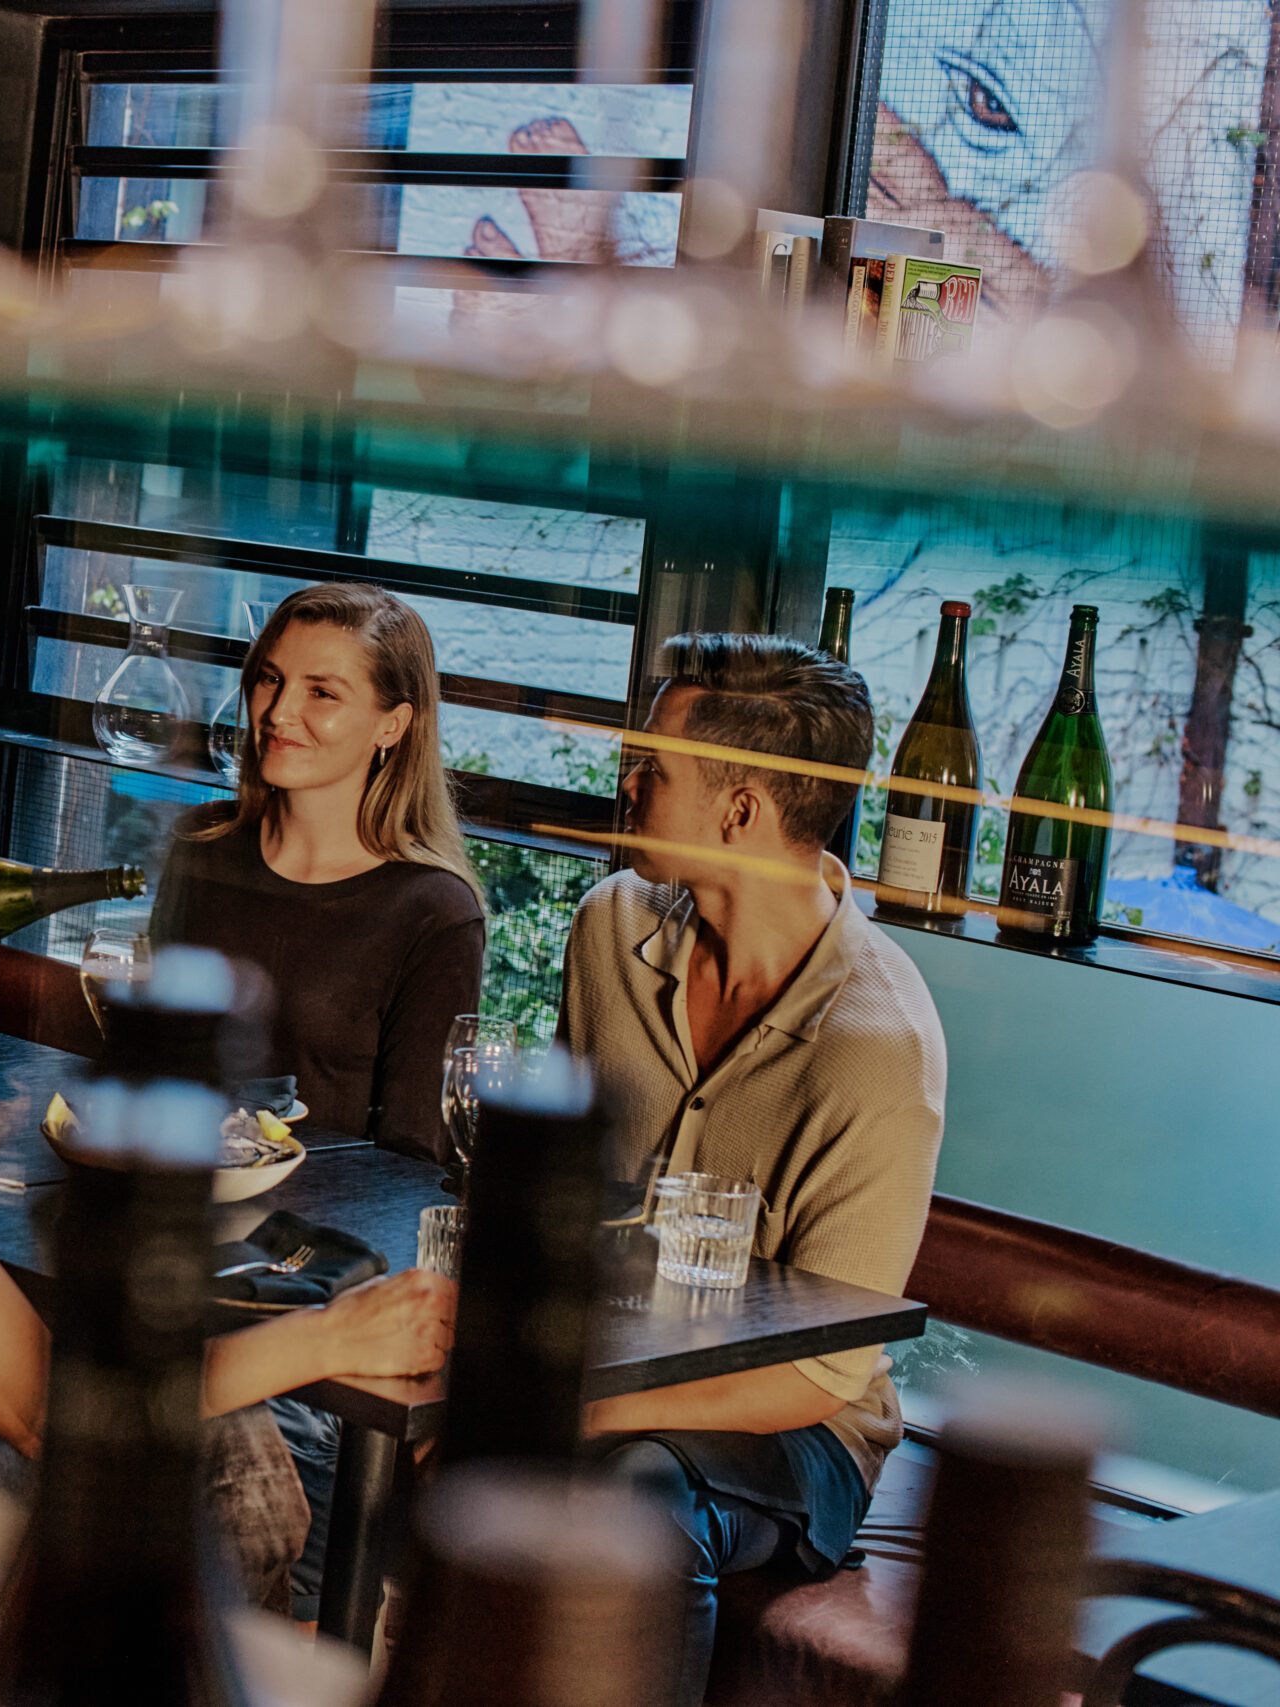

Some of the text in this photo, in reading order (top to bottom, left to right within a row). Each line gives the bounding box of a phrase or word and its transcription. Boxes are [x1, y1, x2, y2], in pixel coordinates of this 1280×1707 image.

[885, 262, 896, 283] RED
[942, 276, 978, 322] RED
[1066, 639, 1085, 678] AYALA
[918, 831, 938, 844] 2015
[1013, 855, 1065, 870] CHAMPAGNE
[1009, 864, 1065, 896] AYALA
